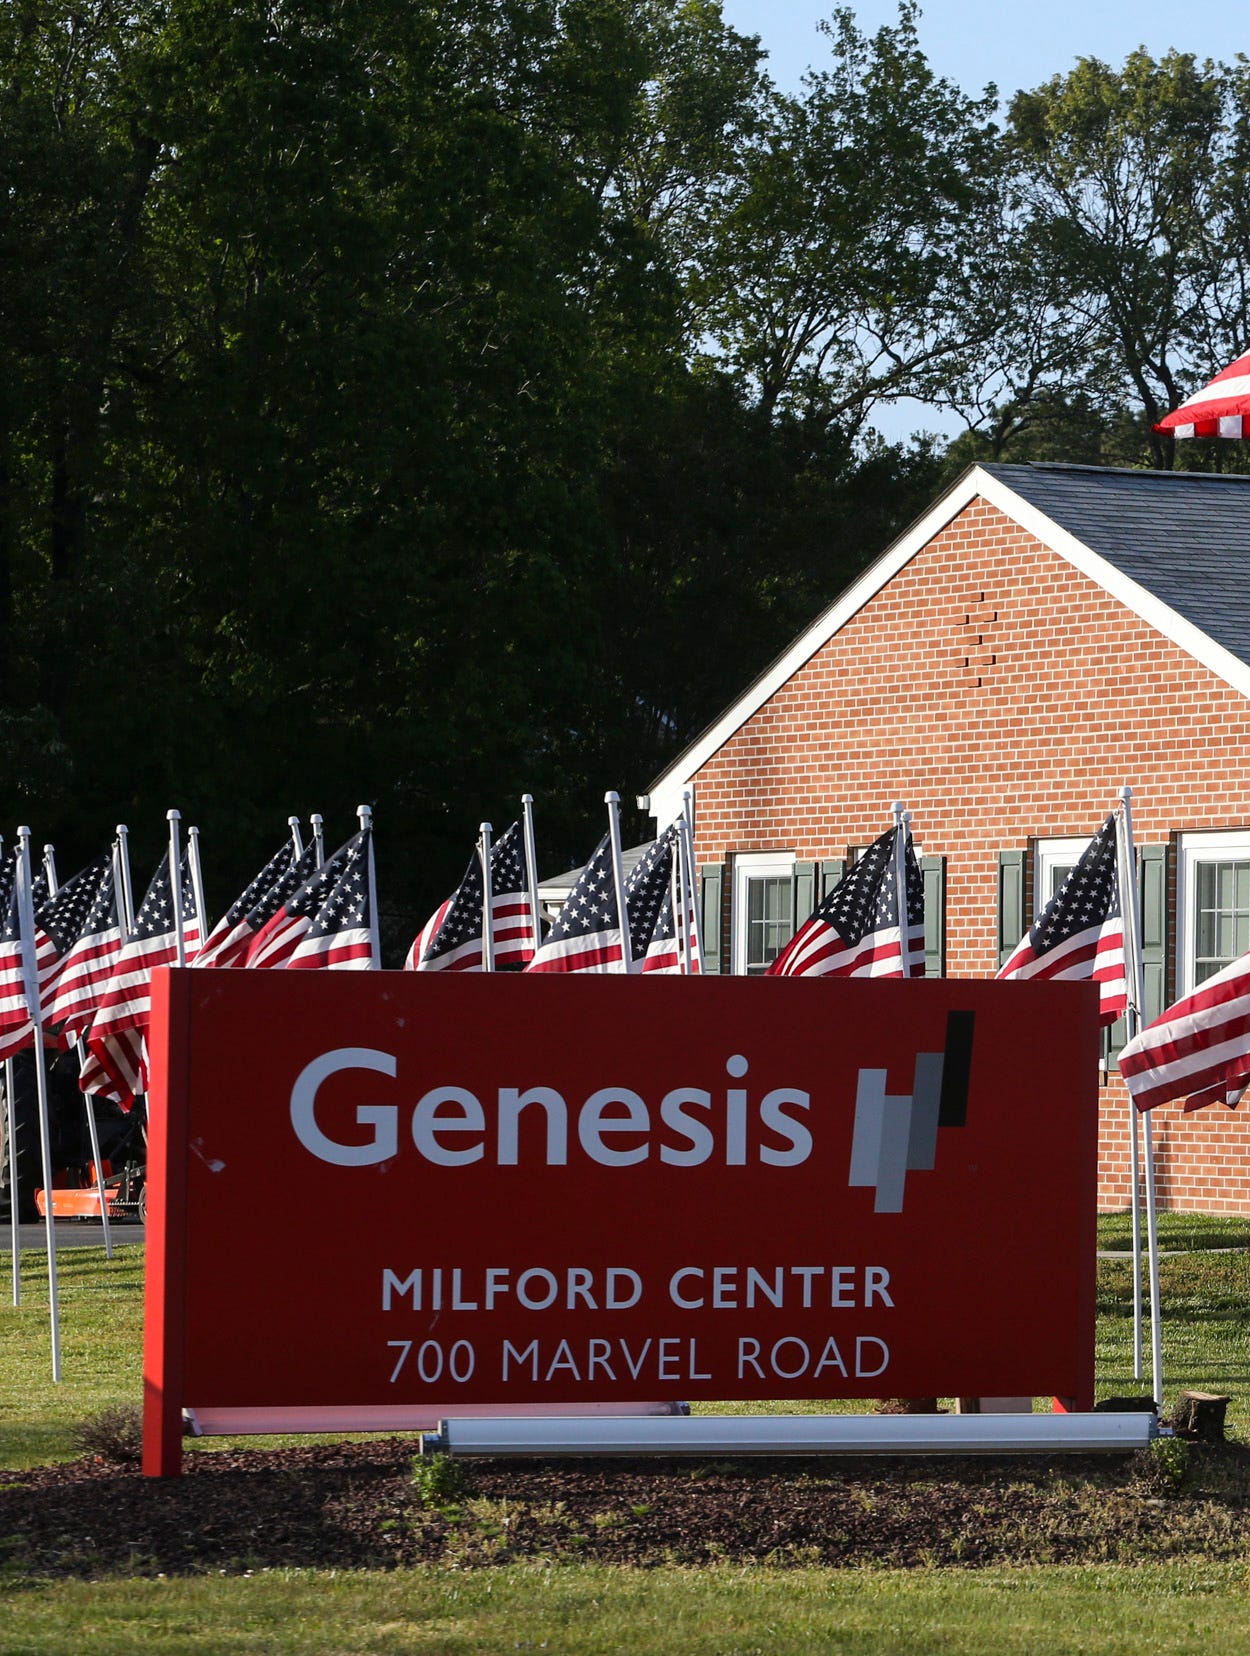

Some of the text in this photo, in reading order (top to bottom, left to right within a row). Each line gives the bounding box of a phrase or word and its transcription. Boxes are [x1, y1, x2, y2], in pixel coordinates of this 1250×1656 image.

[290, 1047, 813, 1167] Genesis
[382, 1266, 895, 1311] MILFORD CENTER
[386, 1336, 889, 1383] 700 MARVEL ROAD
